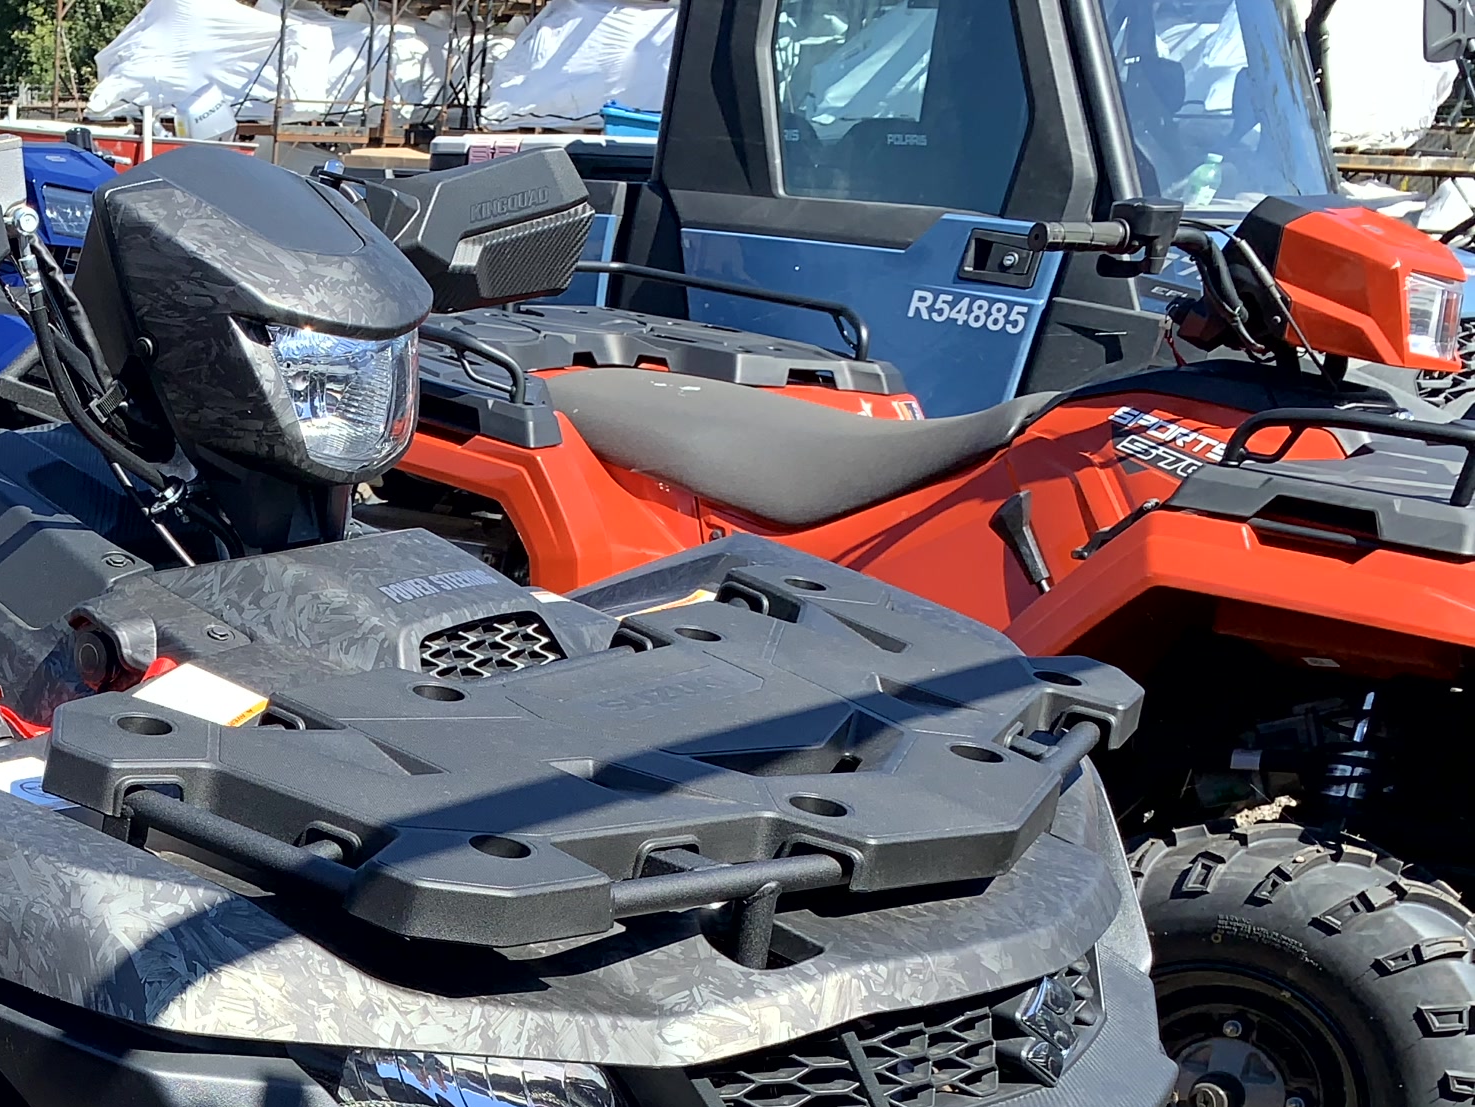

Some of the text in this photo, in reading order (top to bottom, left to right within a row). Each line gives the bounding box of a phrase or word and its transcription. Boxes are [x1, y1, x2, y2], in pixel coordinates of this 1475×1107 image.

[193, 99, 227, 124] HONDA
[886, 133, 928, 146] POLARIS
[469, 186, 551, 223] KINGQUAD
[907, 289, 1029, 334] R54885
[378, 569, 499, 604] POWER STEERING
